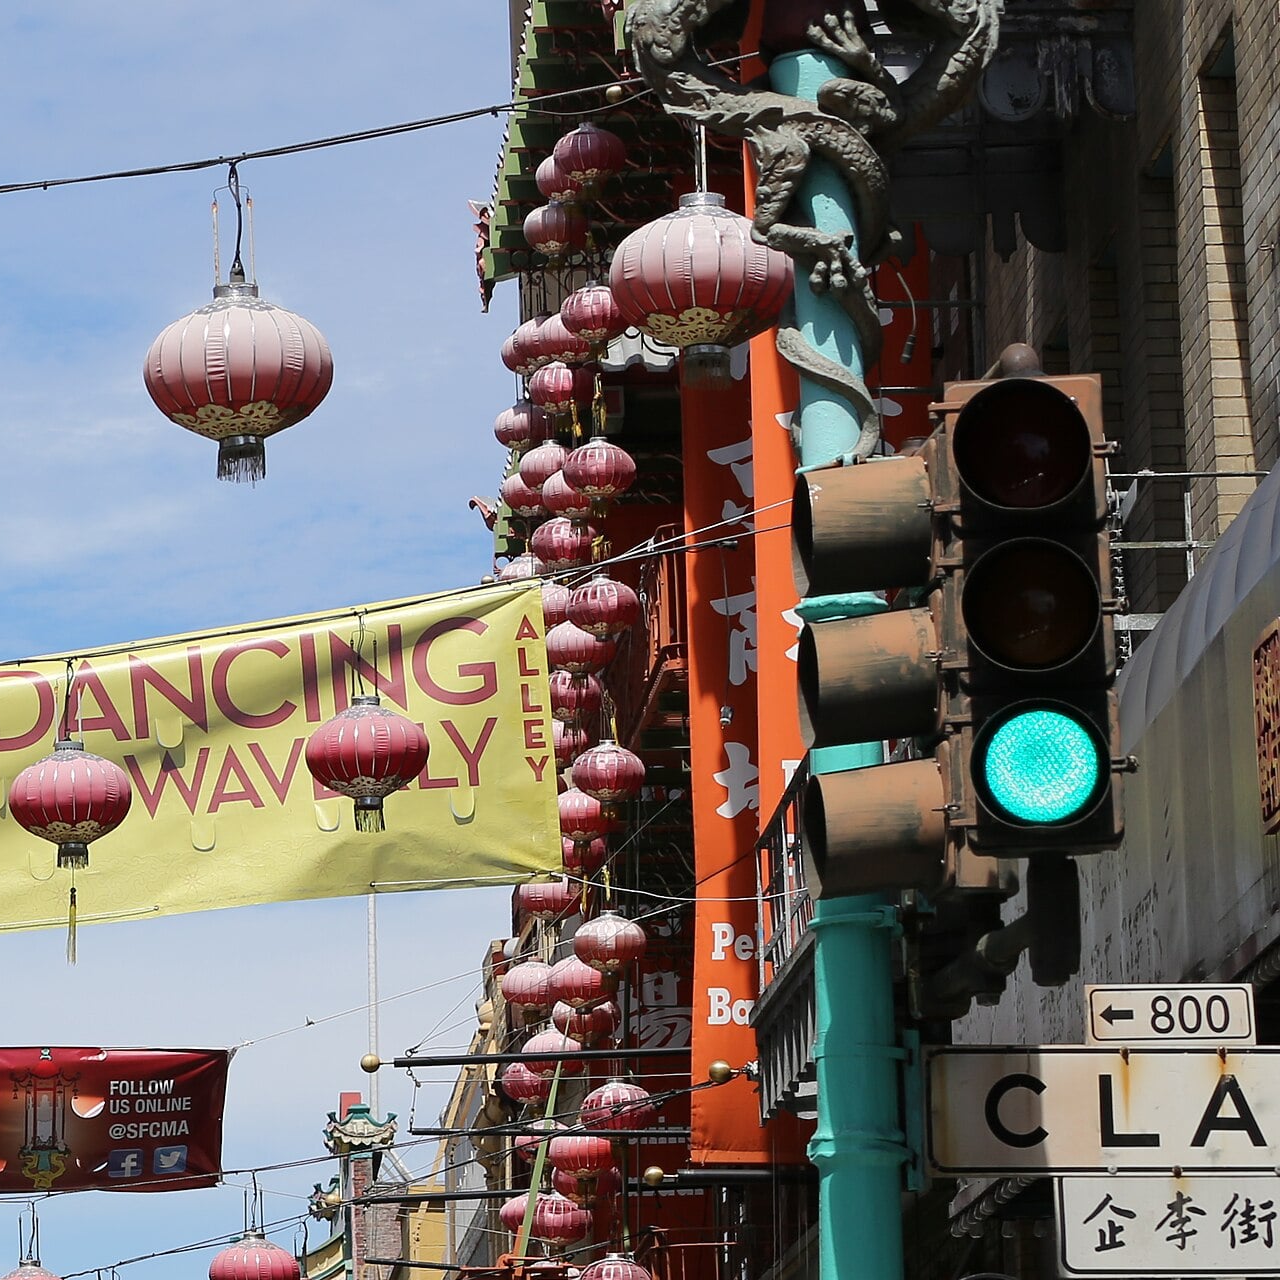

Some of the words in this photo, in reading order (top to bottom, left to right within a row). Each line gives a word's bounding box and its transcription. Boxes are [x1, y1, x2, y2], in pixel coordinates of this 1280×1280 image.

[515, 614, 551, 783] ALLEY
[123, 717, 499, 821] WAVLY
[1149, 995, 1231, 1034] 800
[109, 1079, 175, 1096] FOLLOW
[109, 1099, 131, 1114] US
[135, 1096, 192, 1114] ONLINE
[108, 1119, 190, 1140] @SFCMA
[1082, 1193, 1278, 1254] 企李街
